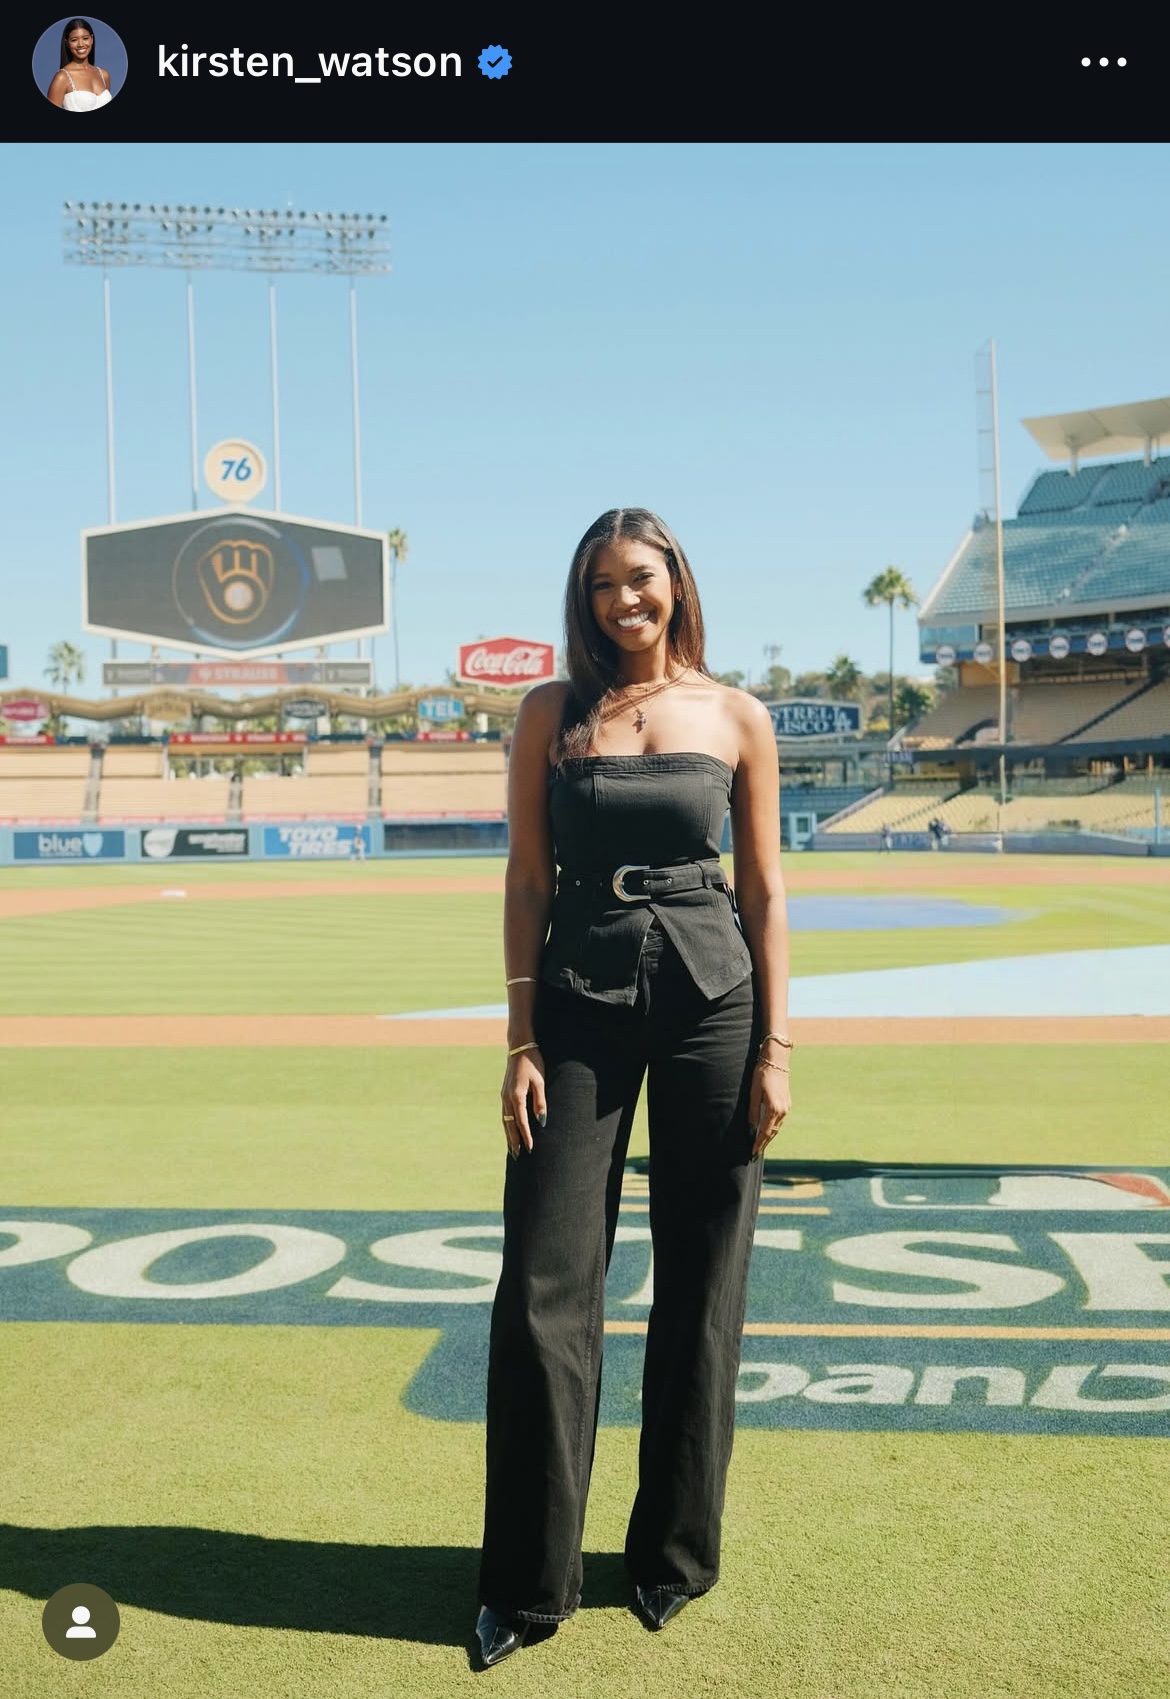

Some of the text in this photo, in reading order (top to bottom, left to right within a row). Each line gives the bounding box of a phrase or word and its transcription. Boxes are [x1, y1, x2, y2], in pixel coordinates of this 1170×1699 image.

[221, 458, 251, 482] 76
[38, 832, 83, 853] blue
[638, 1361, 1170, 1412] oanD
